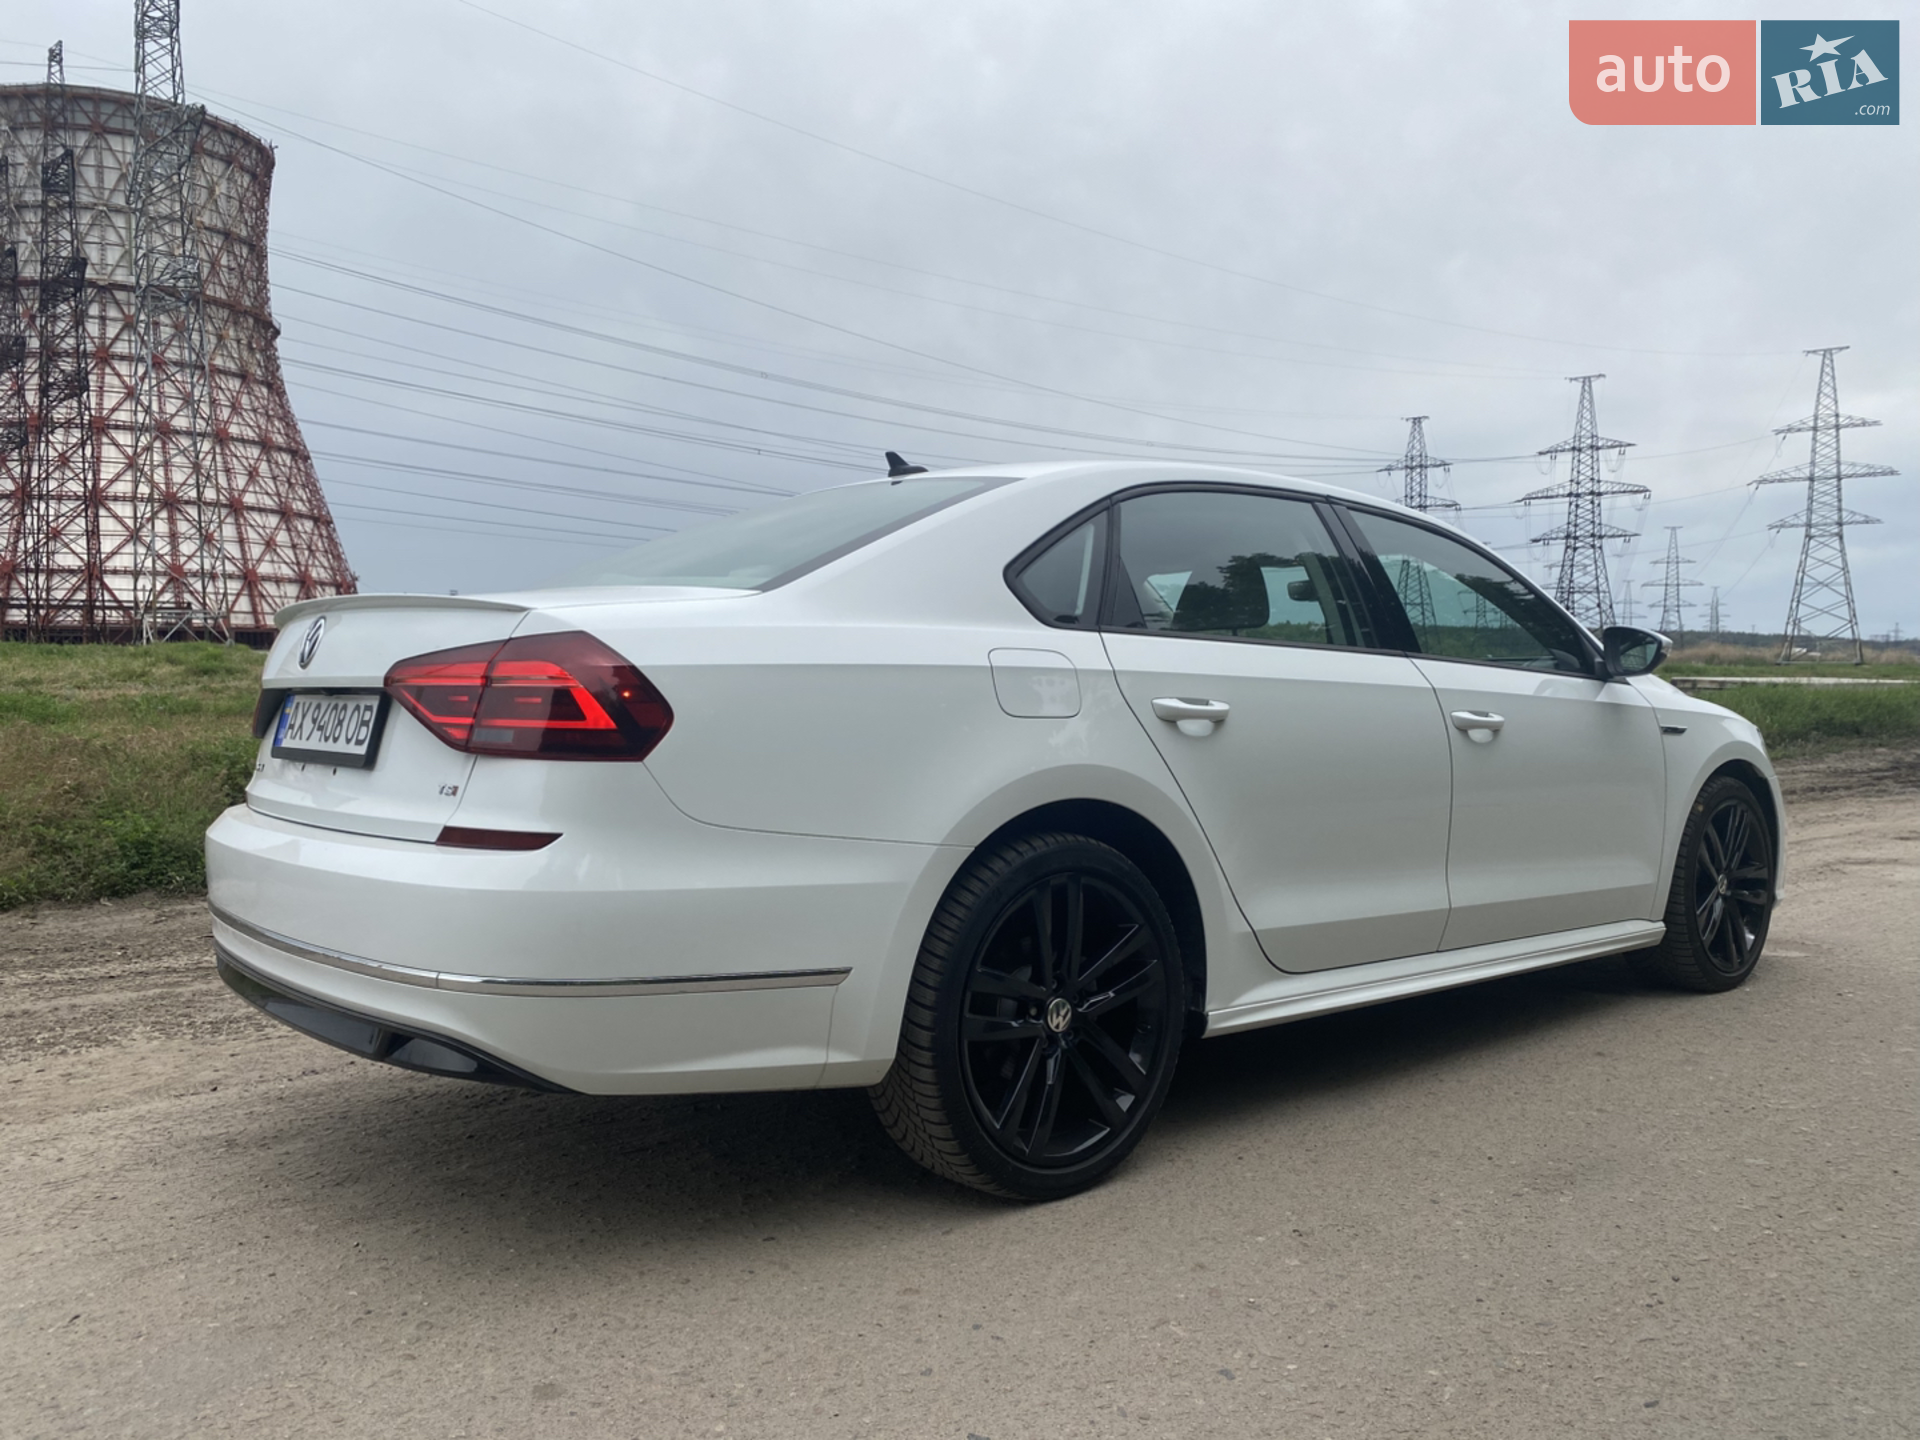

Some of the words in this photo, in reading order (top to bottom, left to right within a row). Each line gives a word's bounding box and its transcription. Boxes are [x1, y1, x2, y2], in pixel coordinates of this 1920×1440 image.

[284, 701, 313, 741] AX
[305, 702, 348, 744] 9408
[345, 704, 374, 746] OB
